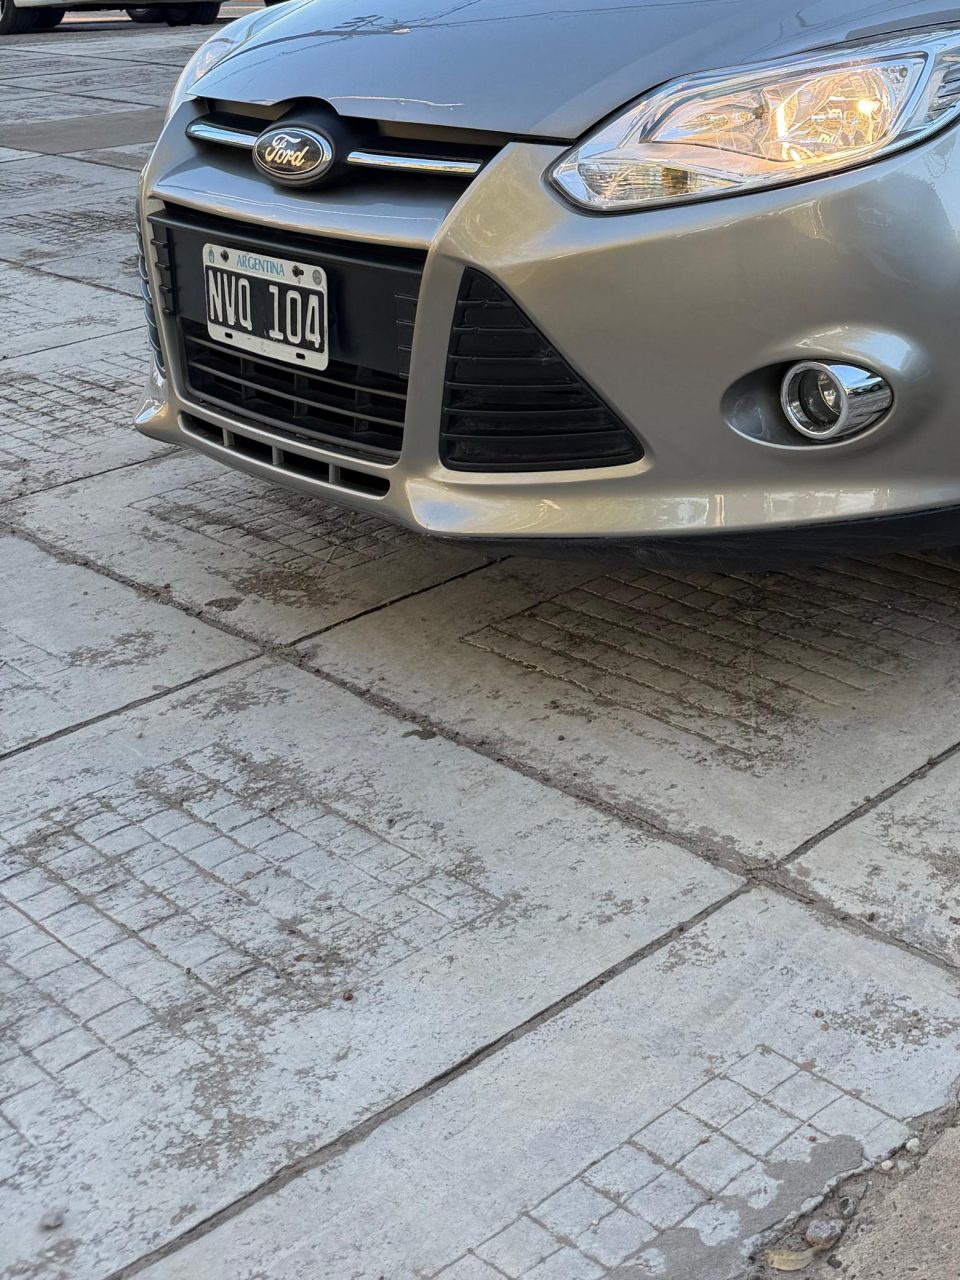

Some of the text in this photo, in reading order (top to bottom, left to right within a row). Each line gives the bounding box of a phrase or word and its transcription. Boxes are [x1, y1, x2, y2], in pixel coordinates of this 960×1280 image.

[264, 133, 309, 168] Ford
[236, 254, 285, 276] ARGENTINA
[209, 271, 321, 348] NVQ 104
